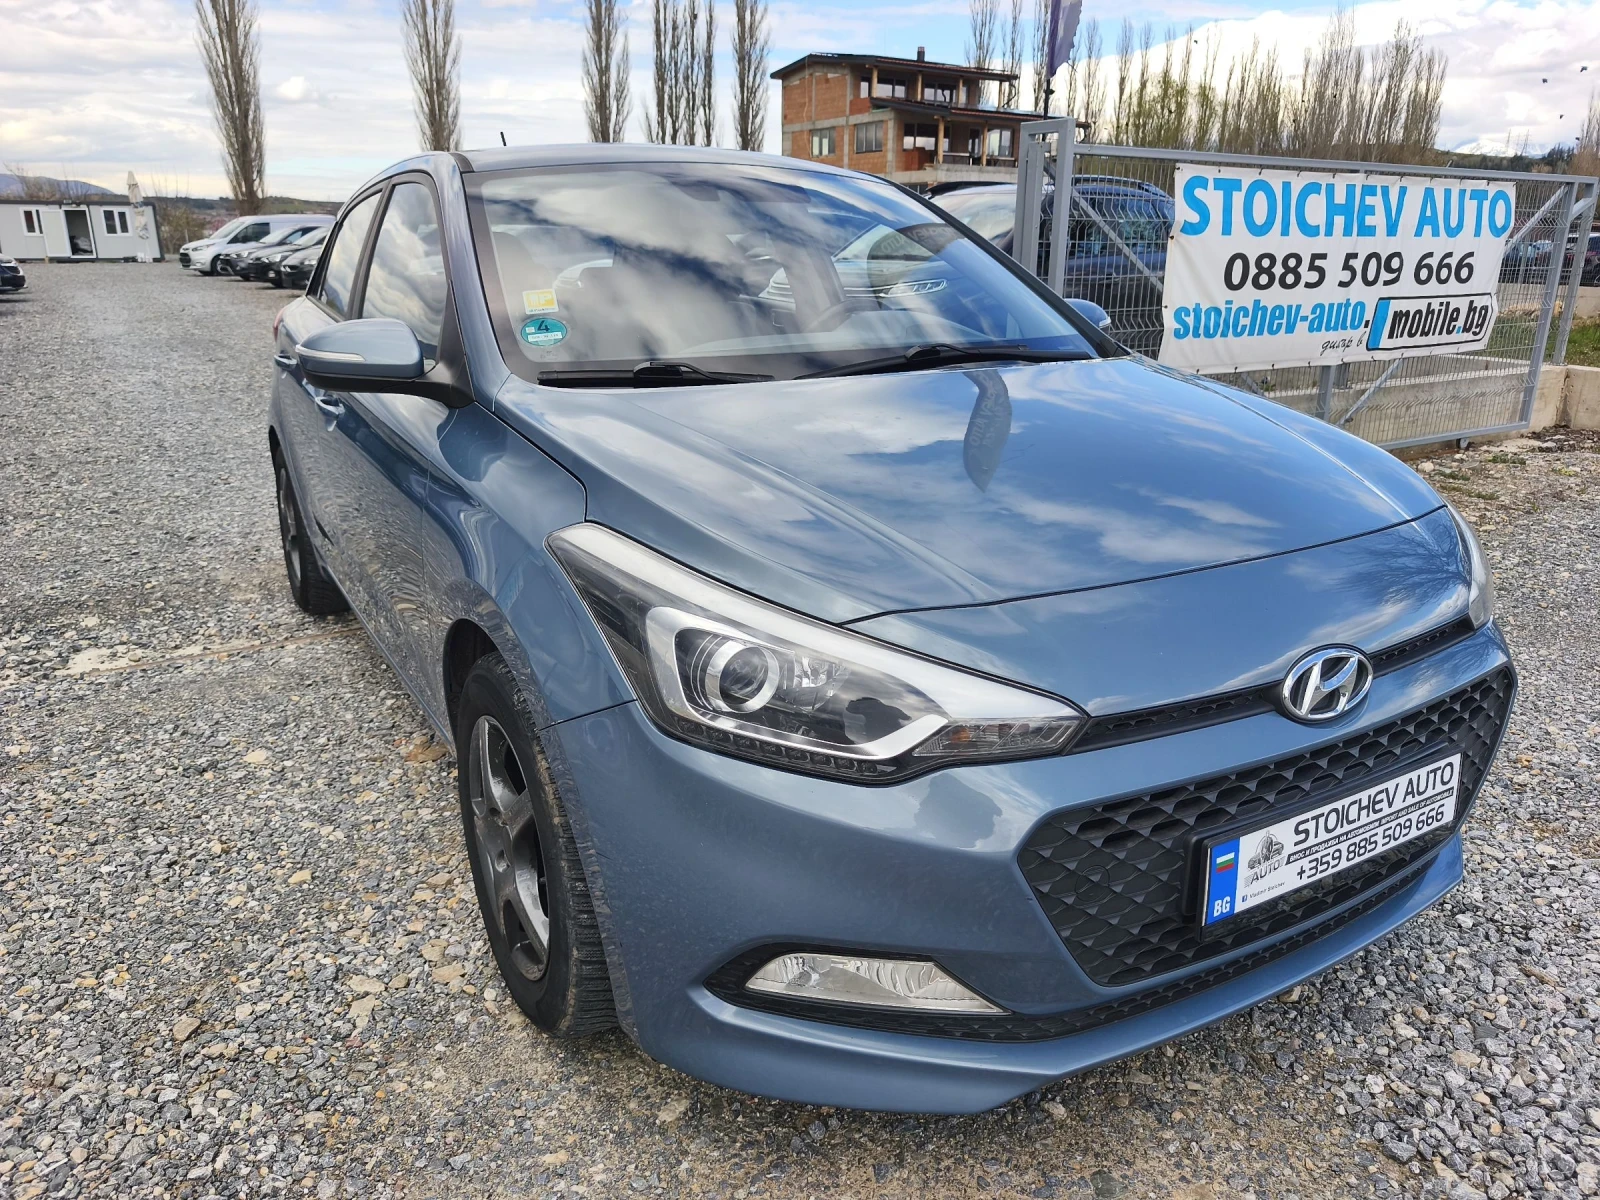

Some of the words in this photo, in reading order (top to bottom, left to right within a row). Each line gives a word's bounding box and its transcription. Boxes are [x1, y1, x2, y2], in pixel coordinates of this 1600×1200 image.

[1180, 175, 1407, 238] STOICHEV
[1414, 186, 1512, 238] AUTO
[1224, 252, 1328, 290] 0885
[1338, 252, 1403, 287] 509
[1414, 251, 1475, 285] 666
[537, 320, 550, 332] 4
[1387, 300, 1489, 340] mobile.bg
[1294, 783, 1399, 846] STOICHEV
[1402, 761, 1454, 803] AUTO
[1297, 848, 1342, 881] +359
[1346, 832, 1378, 862] 885
[1381, 818, 1412, 848] 509
[1416, 803, 1445, 831] 666
[1250, 859, 1281, 884] AUTO
[1213, 896, 1231, 918] BG
